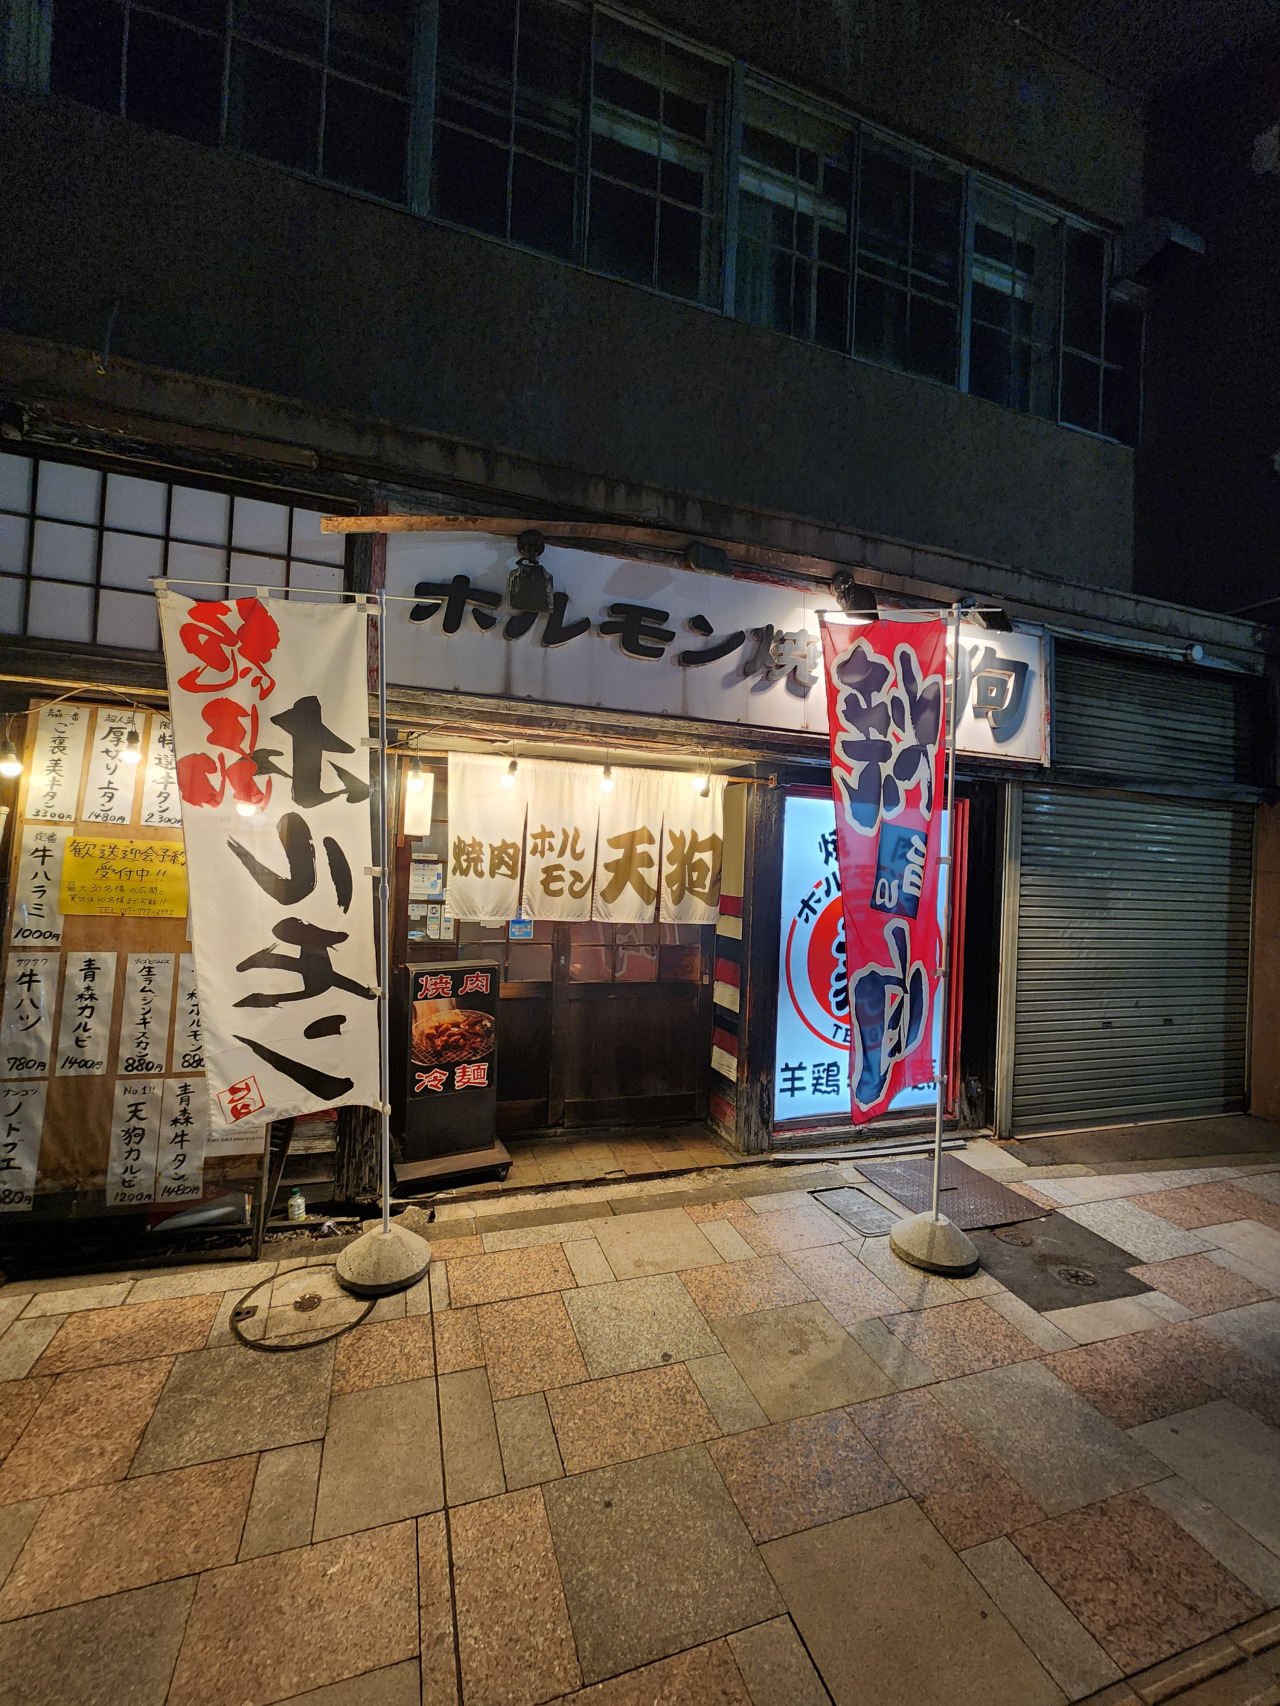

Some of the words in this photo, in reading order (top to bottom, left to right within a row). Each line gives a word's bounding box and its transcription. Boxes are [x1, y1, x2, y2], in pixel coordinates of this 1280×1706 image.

[152, 733, 177, 813] 特選牛タン
[88, 811, 126, 823] 1480円
[34, 831, 58, 844] 定番
[68, 839, 187, 867] 歓送迎会予約
[452, 835, 521, 880] 焼肉
[599, 825, 723, 906] 天狗
[28, 846, 54, 919] 牛ハラミ
[97, 906, 118, 914] TEL
[13, 927, 61, 941] 1000円
[14, 968, 41, 1031] 牛ハツ
[417, 971, 491, 1000] 焼肉
[73, 957, 102, 1049] 青森カルビ
[134, 965, 158, 1058] 生ラムジンギスカン
[7, 1056, 47, 1072] 780円
[60, 1054, 103, 1071] 1400円
[124, 1056, 163, 1073] 880円
[414, 1062, 490, 1093] 冷麺
[121, 1101, 149, 1188] 天狗カルビ
[169, 1083, 195, 1181] 青森牛タン
[113, 1191, 153, 1203] 1200円
[161, 1185, 200, 1198] 1480円
